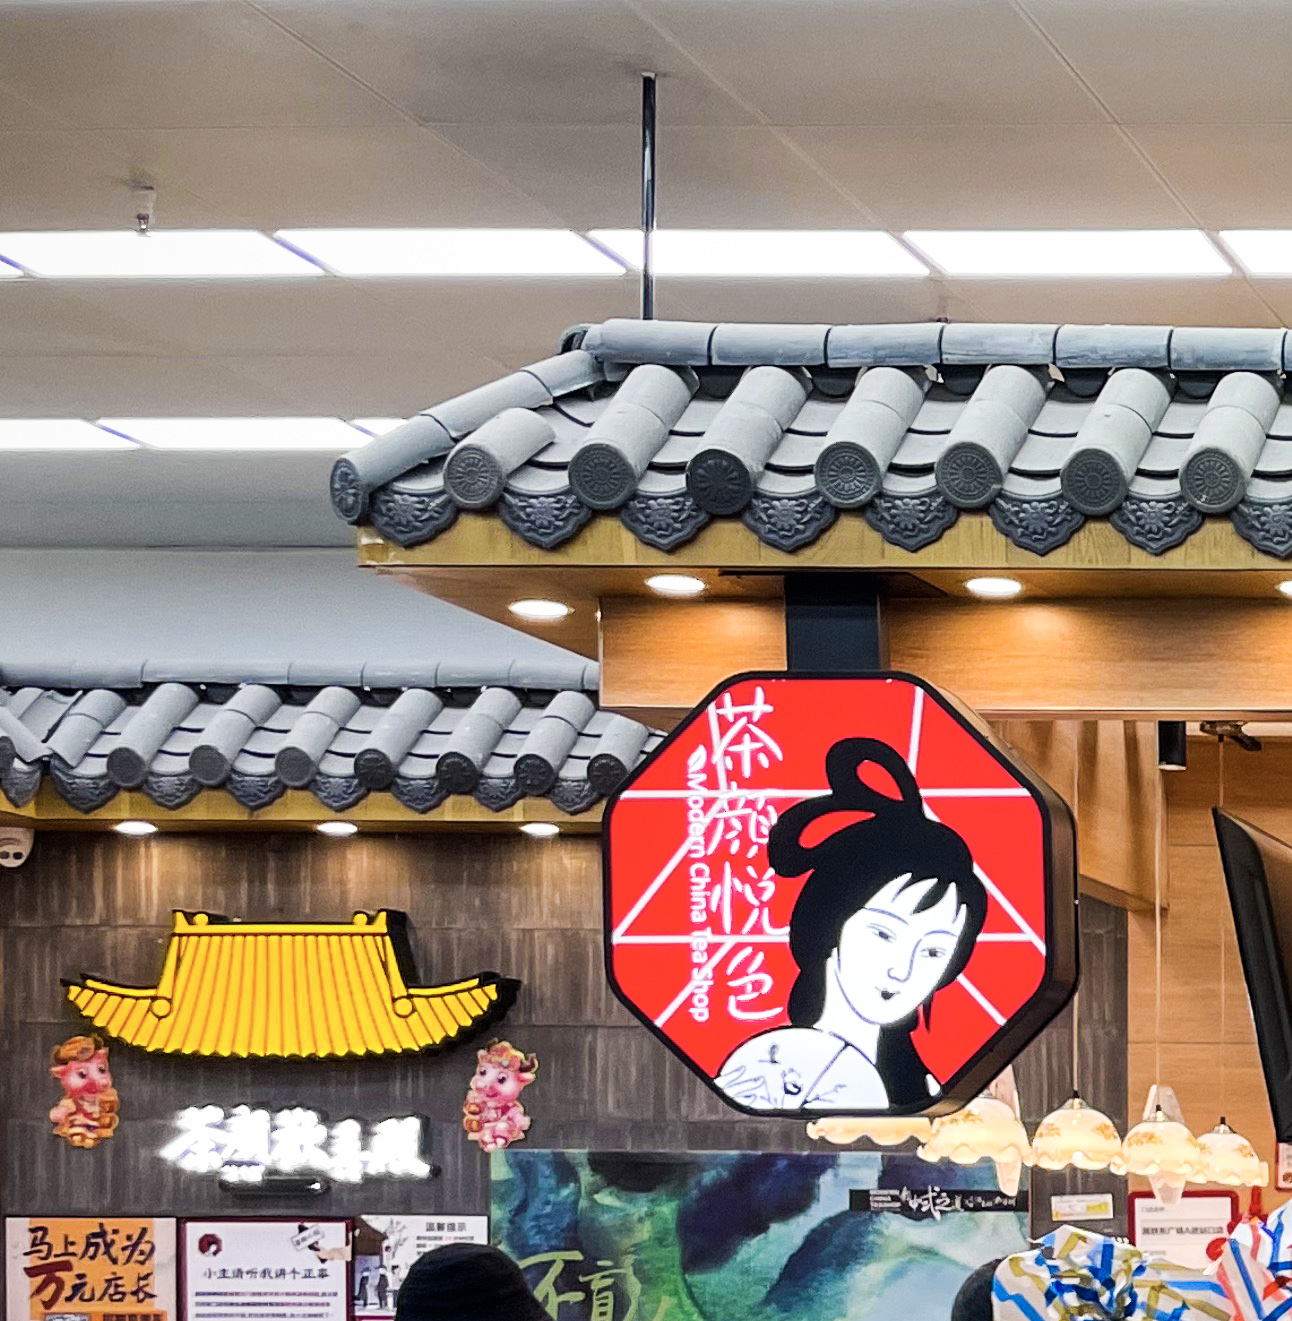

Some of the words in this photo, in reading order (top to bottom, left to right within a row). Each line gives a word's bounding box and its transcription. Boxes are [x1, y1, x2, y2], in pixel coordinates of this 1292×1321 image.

[687, 773, 708, 858] Modern
[709, 686, 790, 1022] 茶颜悦色
[688, 862, 710, 925] China
[689, 929, 711, 965] Tea
[688, 968, 711, 1023] Shop
[23, 1223, 156, 1265] 马上成为
[23, 1260, 157, 1310] 万元店长
